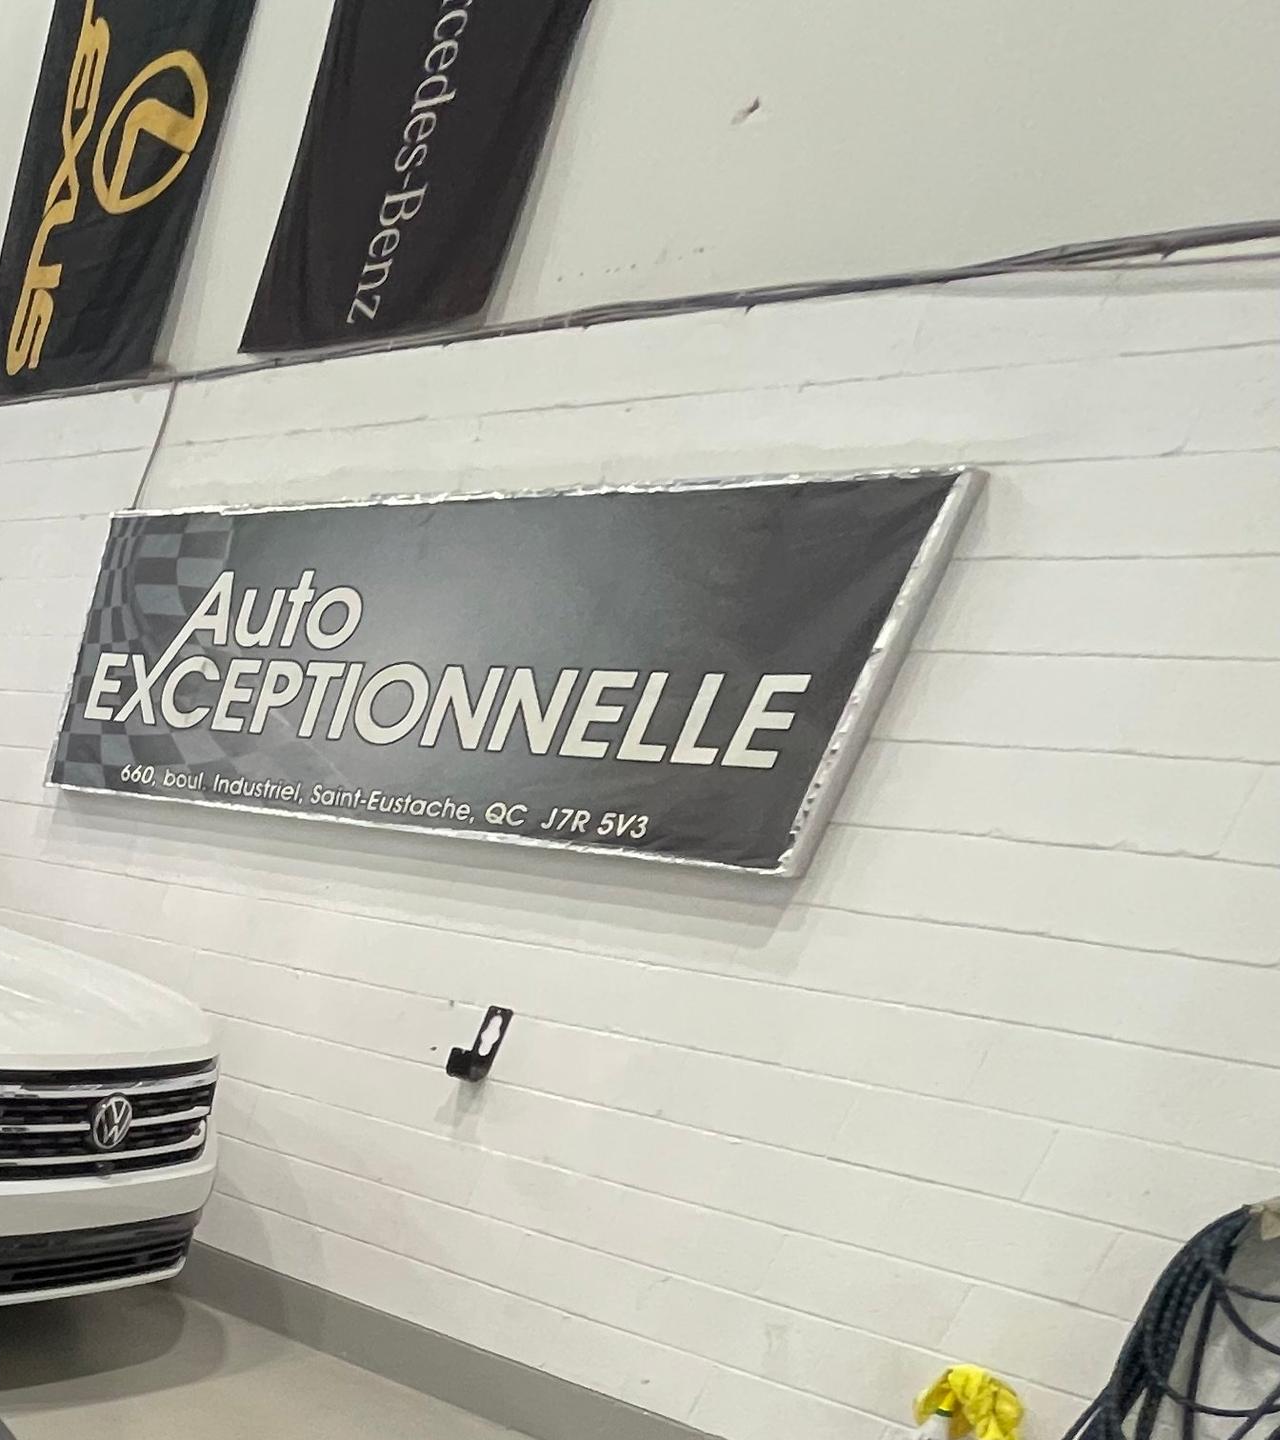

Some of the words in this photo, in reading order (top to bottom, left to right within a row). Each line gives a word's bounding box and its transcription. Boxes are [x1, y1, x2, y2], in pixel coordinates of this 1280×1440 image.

[6, 0, 111, 377] EXUS
[346, 0, 472, 324] cedes-Benz
[154, 568, 364, 652] Auto
[83, 651, 812, 769] EXCEPTIONNELLE
[120, 763, 157, 788] 660,
[162, 768, 207, 792] boul.
[212, 773, 304, 805] Industriel,
[309, 784, 476, 825] Saint-Eustache,
[484, 802, 529, 827] QC
[540, 807, 591, 833] J7R
[596, 812, 649, 840] 5V3
